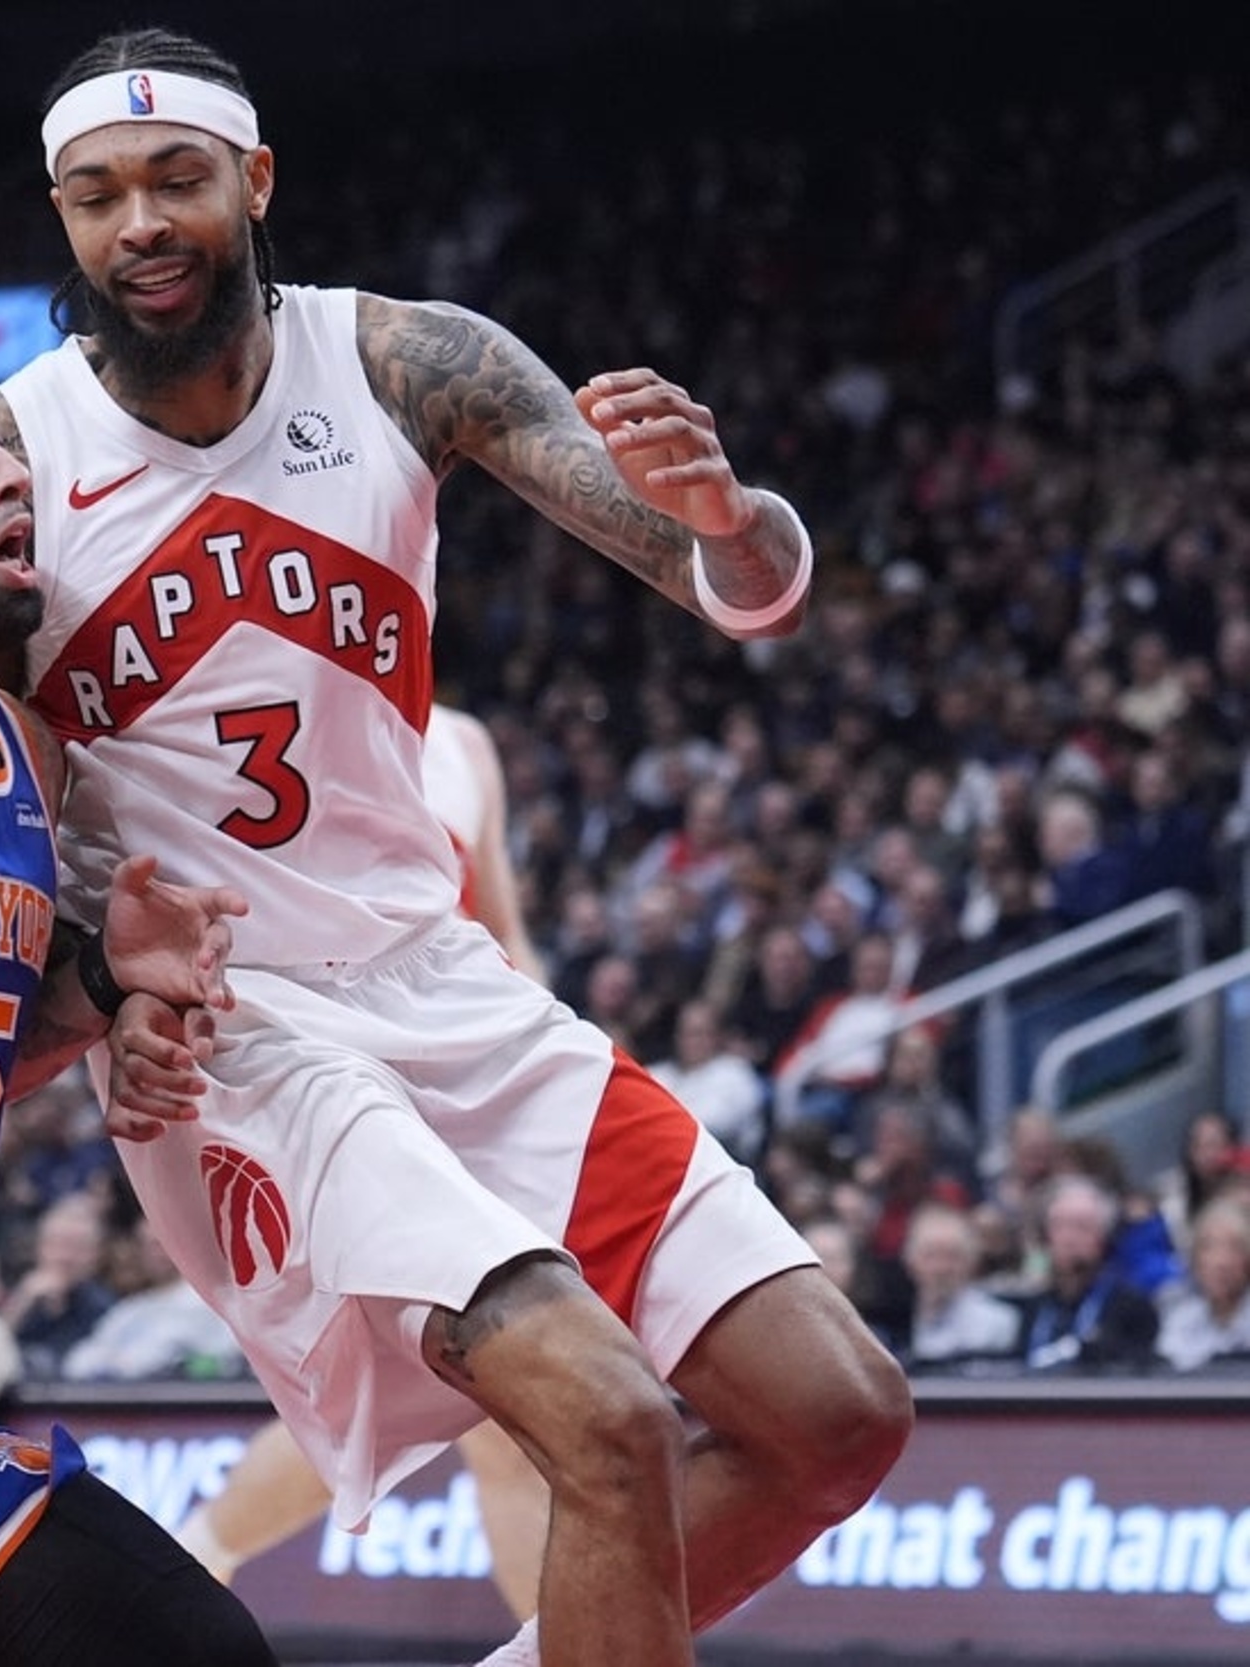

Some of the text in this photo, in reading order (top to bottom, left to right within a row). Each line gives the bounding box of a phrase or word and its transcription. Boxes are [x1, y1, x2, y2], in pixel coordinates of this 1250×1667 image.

[282, 448, 354, 476] Sun Life
[67, 532, 402, 729] RAPTORS
[214, 700, 310, 849] 3
